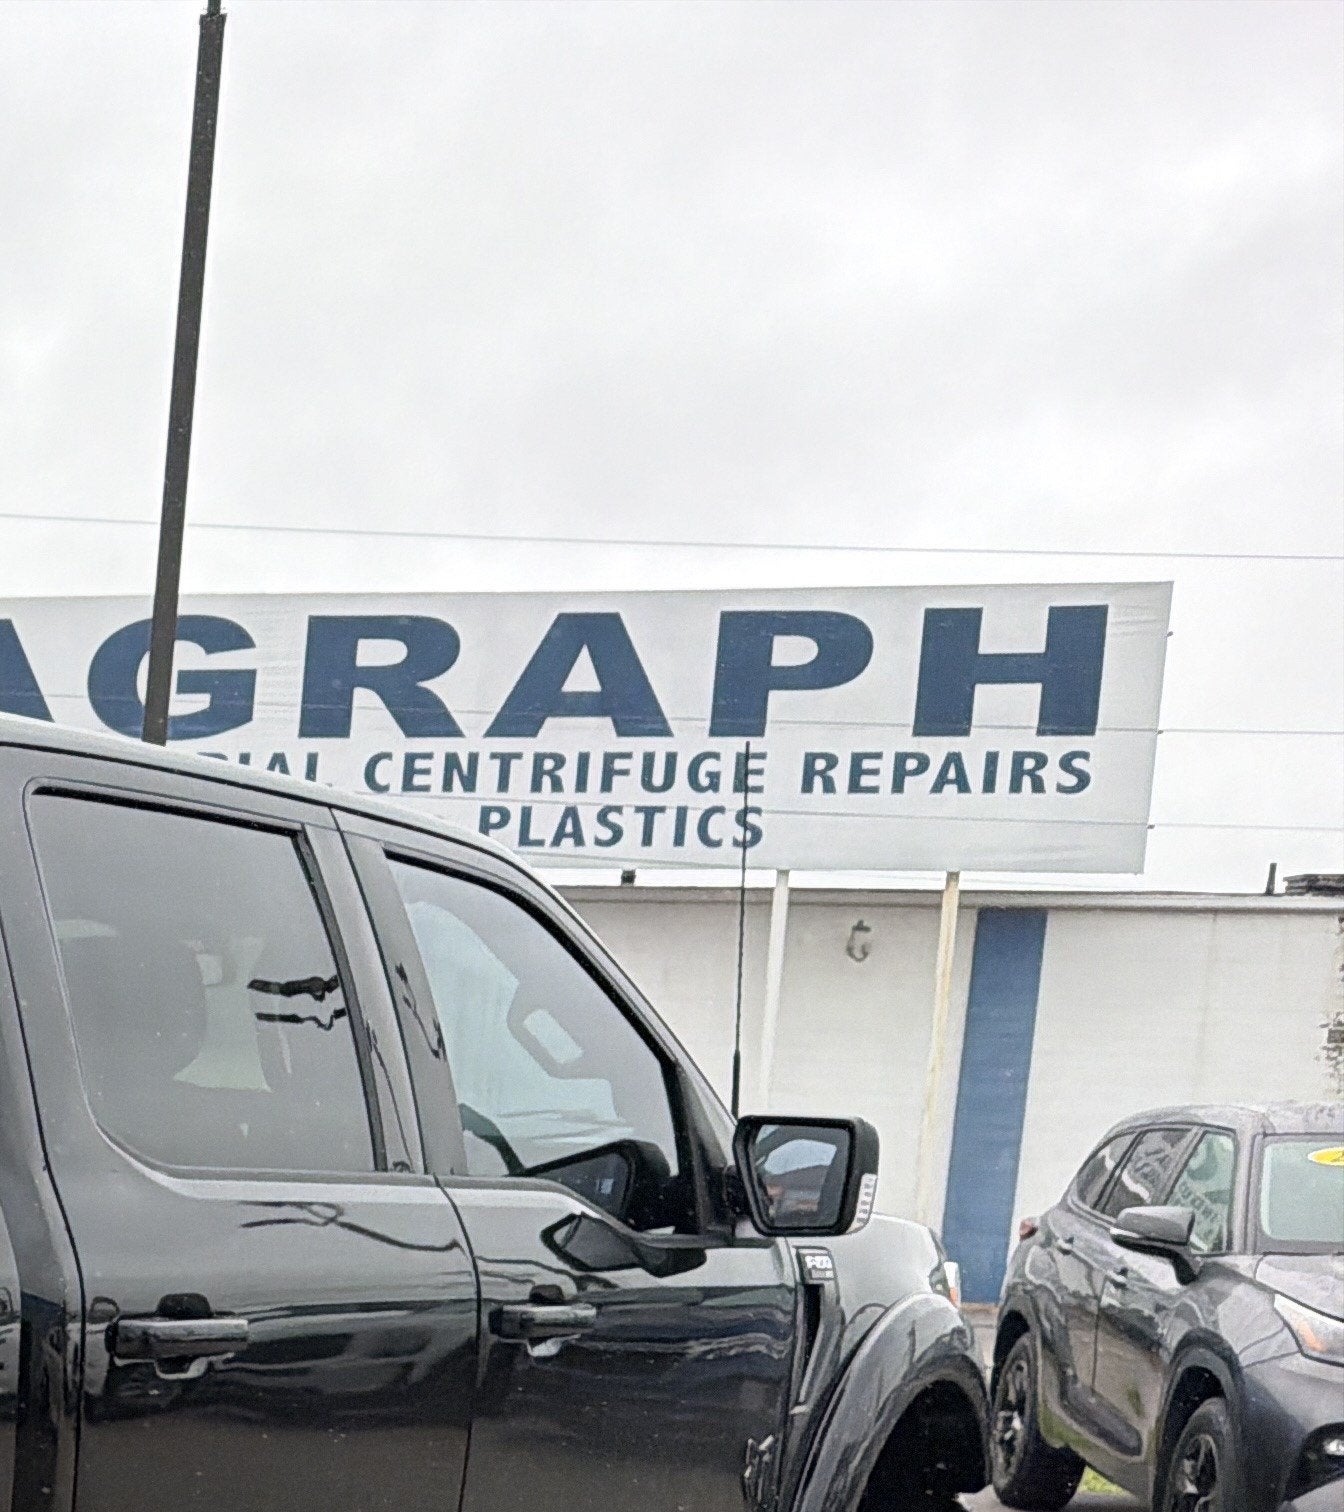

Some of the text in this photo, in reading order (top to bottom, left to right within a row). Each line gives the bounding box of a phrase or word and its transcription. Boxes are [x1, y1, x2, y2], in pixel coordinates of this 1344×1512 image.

[364, 750, 769, 794] CENTRIFUGE
[800, 750, 1092, 795] REPAIRS
[478, 805, 764, 848] PLASTICS
